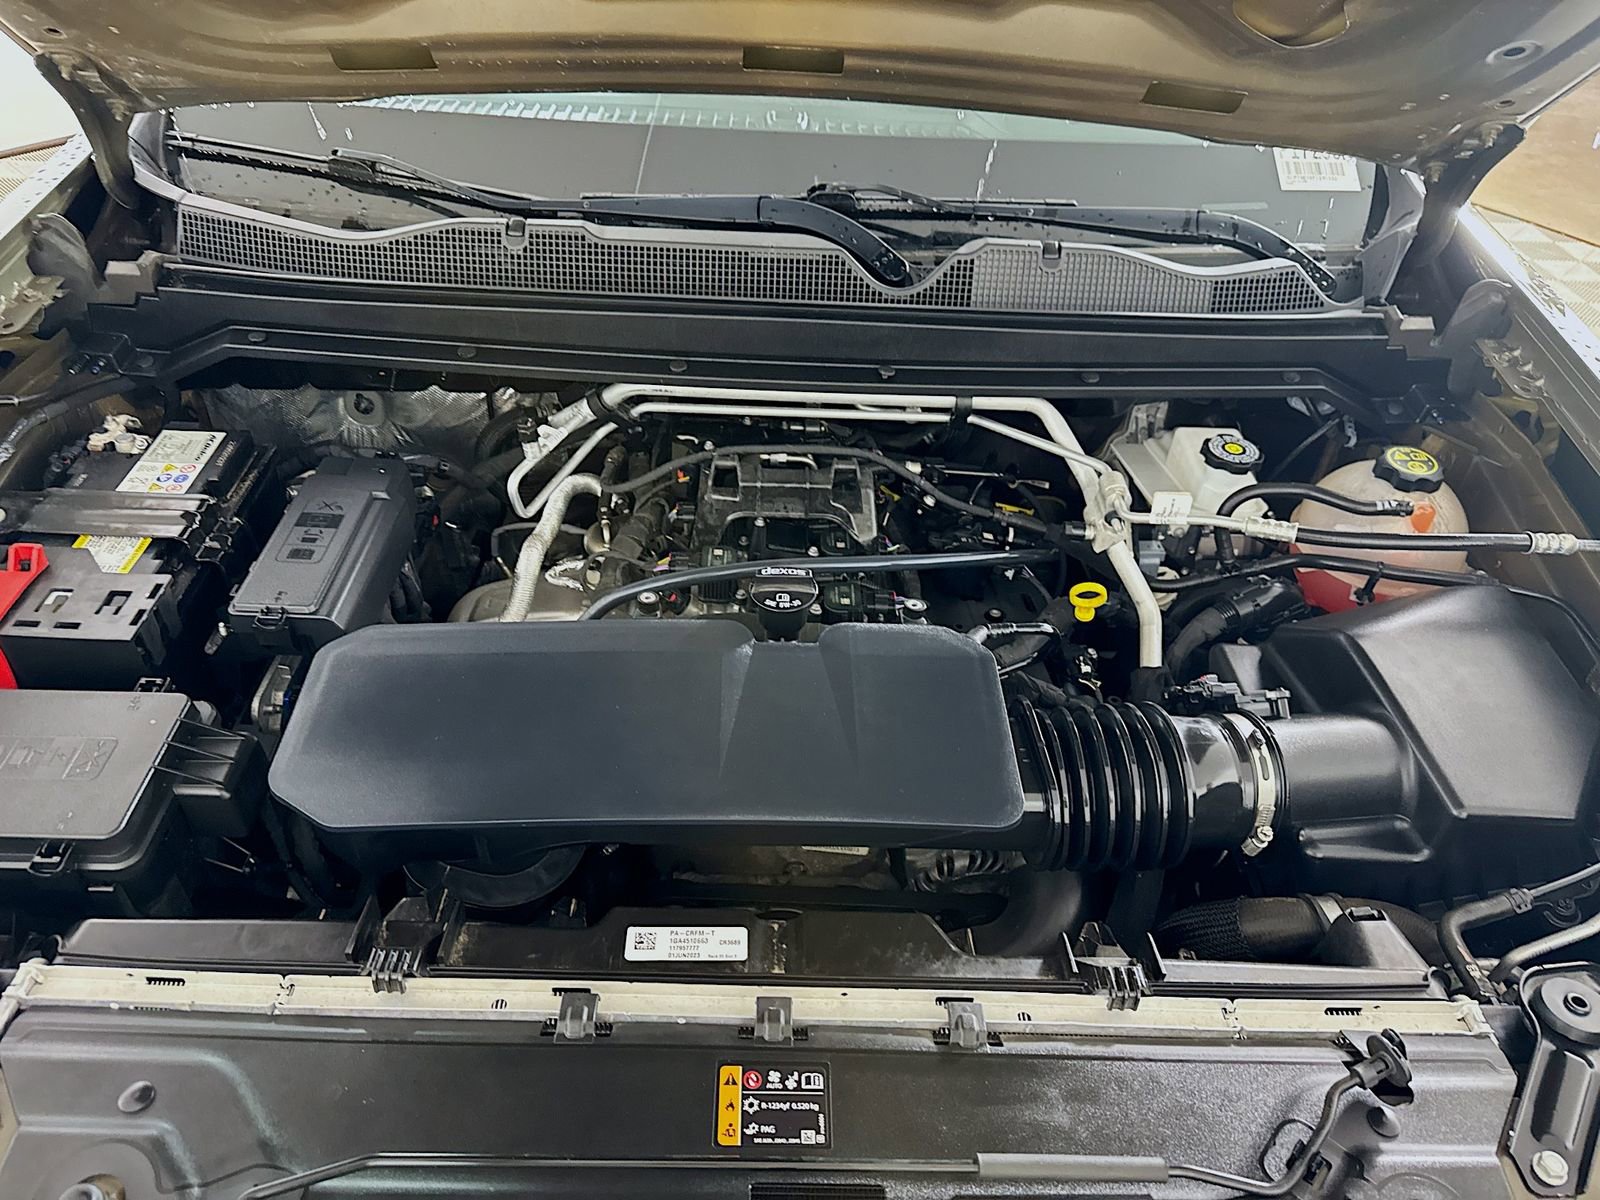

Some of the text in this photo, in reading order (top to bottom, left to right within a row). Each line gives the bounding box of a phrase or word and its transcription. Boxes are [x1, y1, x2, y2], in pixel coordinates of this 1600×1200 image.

[761, 567, 807, 575] dexos
[791, 1102, 810, 1110] 0.520
[810, 1102, 820, 1111] kg
[760, 1125, 776, 1134] PAG
